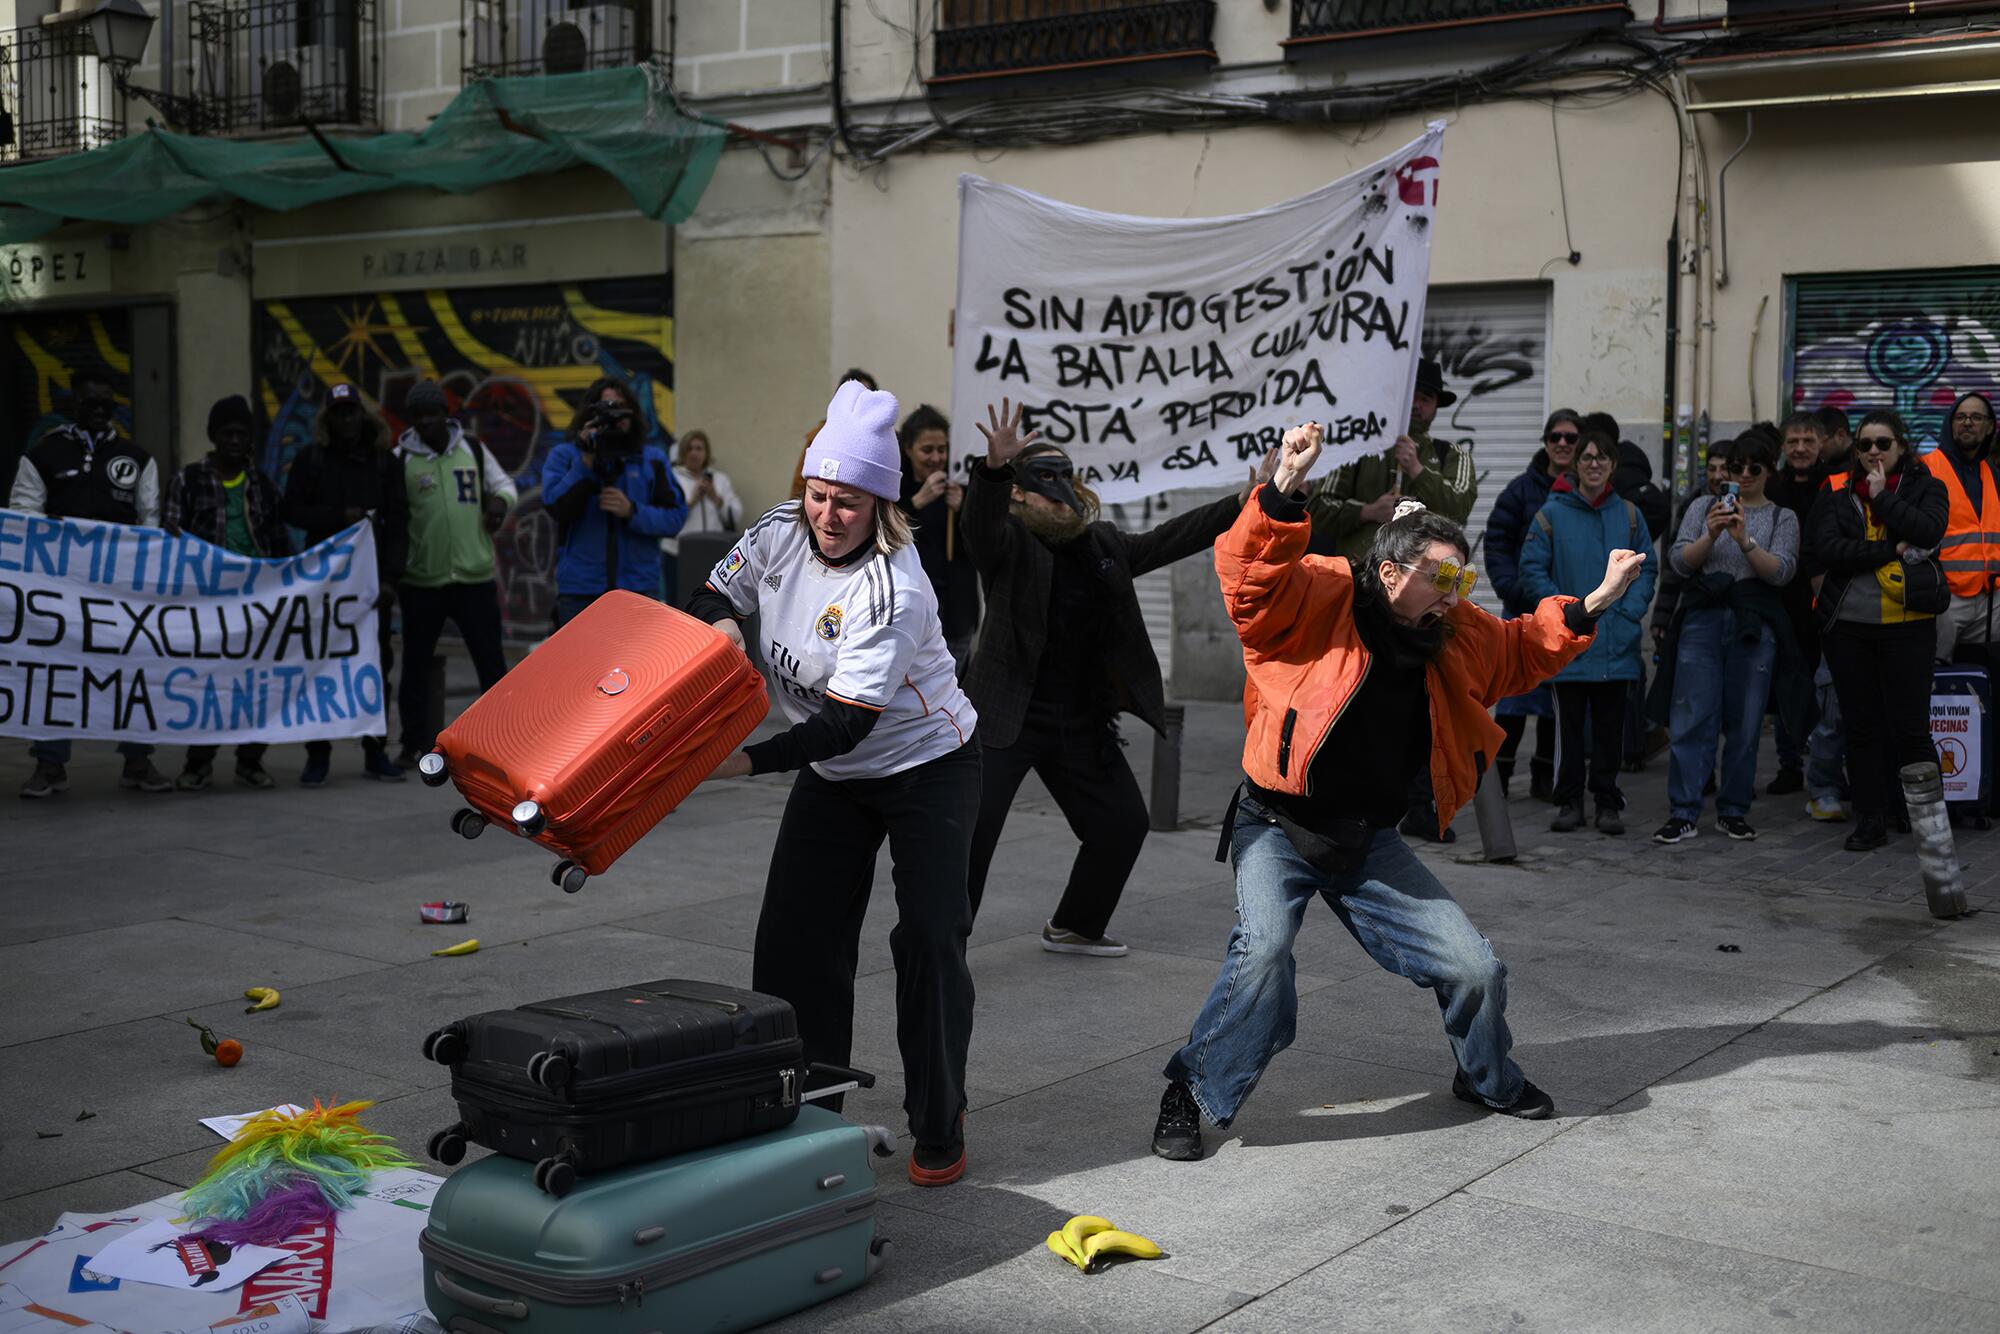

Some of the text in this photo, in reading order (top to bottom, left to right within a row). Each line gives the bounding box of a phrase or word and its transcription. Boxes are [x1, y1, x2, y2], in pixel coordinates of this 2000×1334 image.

[363, 243, 527, 279] PIZZA BAR
[1003, 287, 1084, 333] SIN
[974, 291, 1409, 390] LA BATALLA CULTURAL
[1021, 397, 1137, 444] ESTÁ
[453, 470, 478, 503] H
[771, 640, 800, 678] Fly
